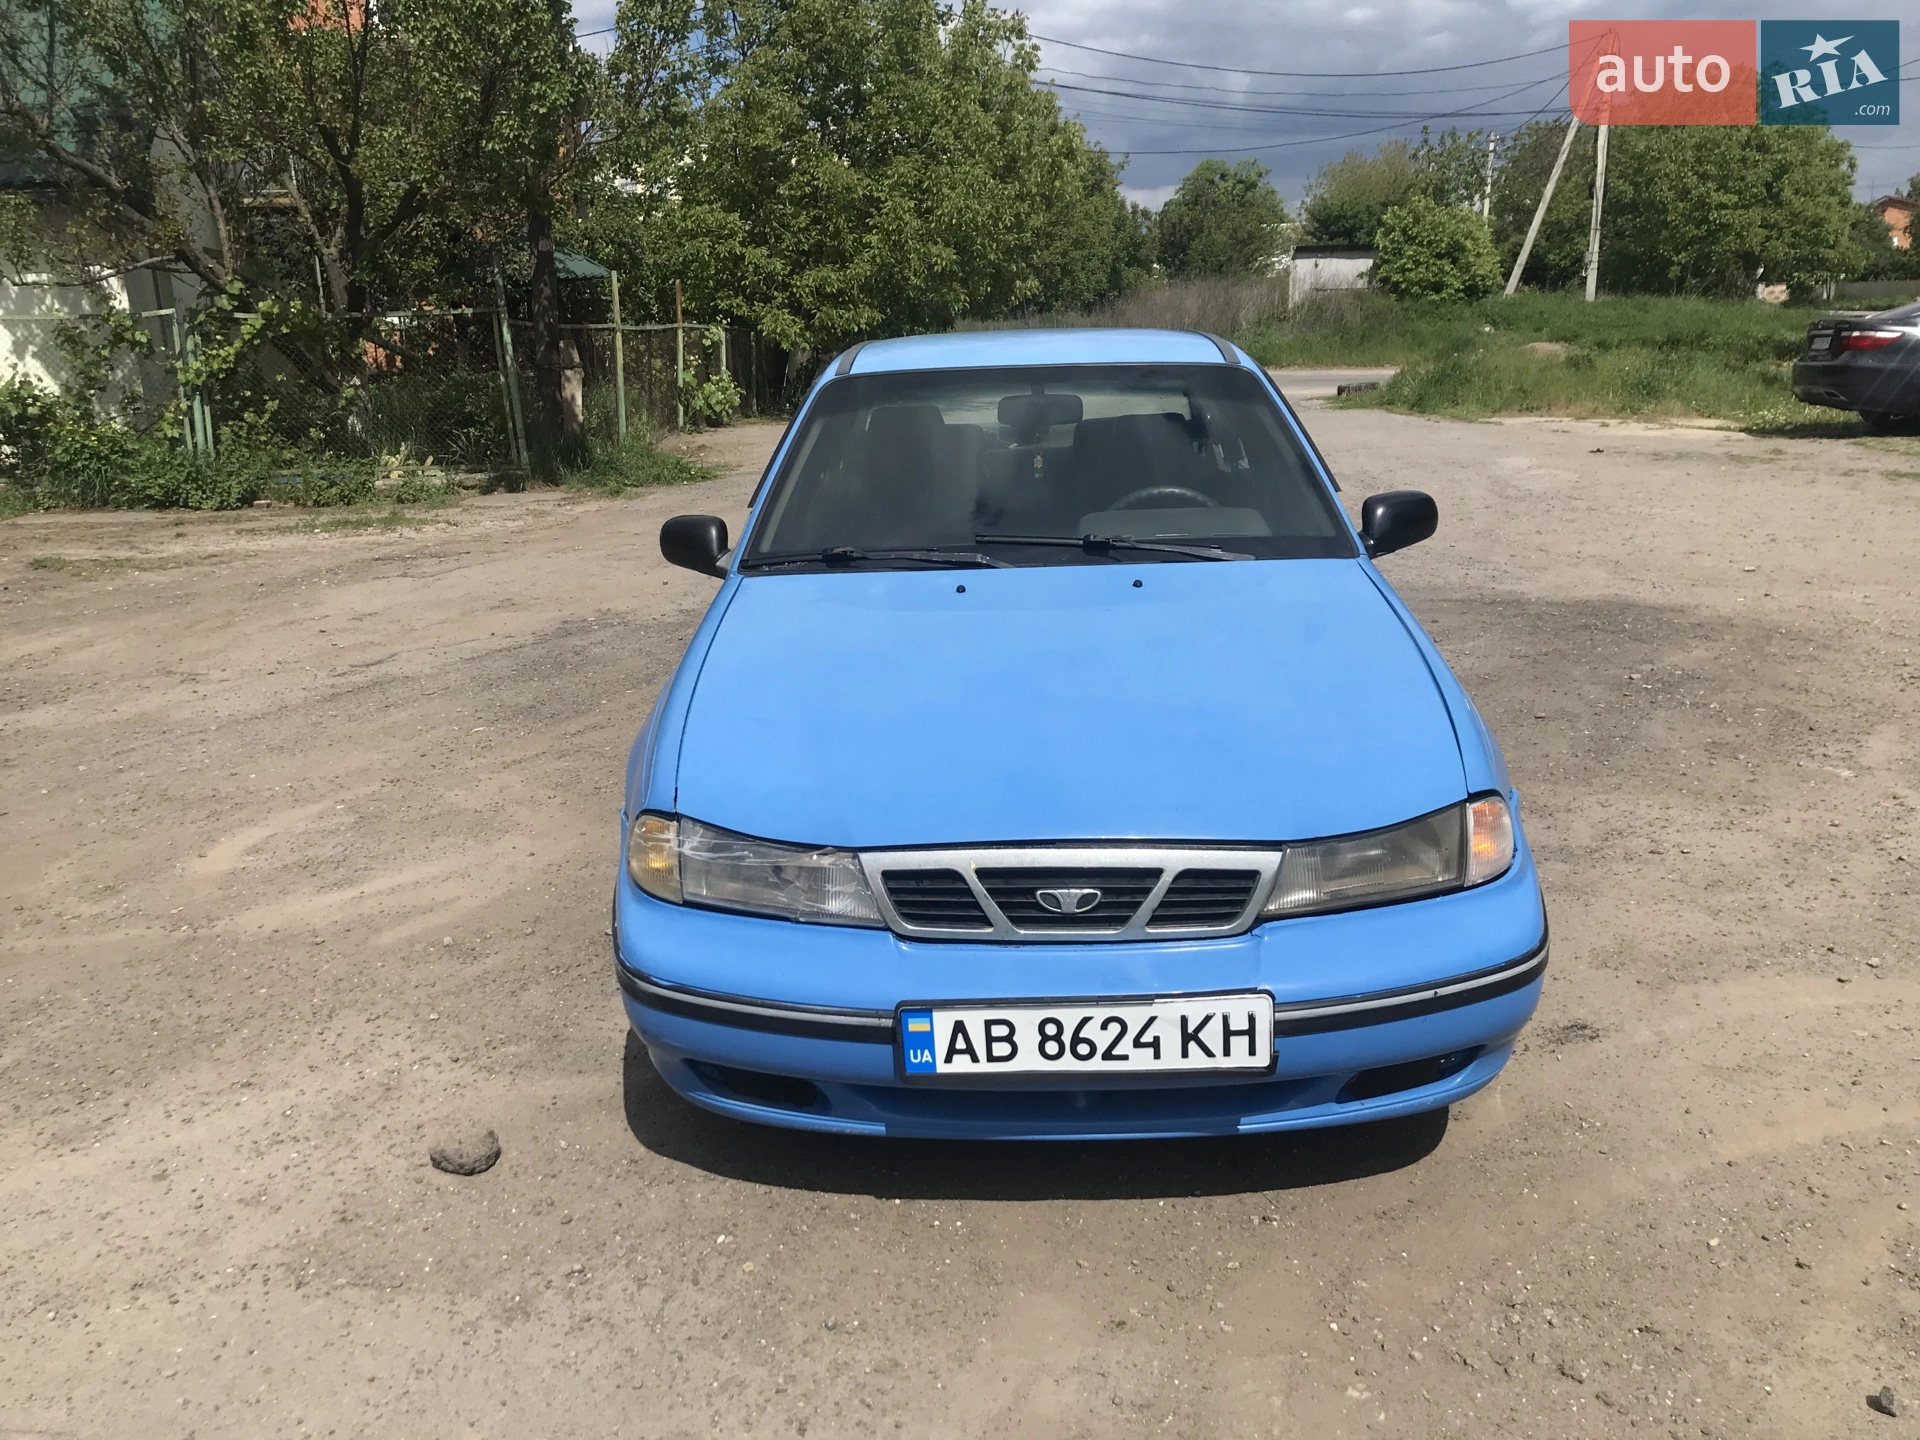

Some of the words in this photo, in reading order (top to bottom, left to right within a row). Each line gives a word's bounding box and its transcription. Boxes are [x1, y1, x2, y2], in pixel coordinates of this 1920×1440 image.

[943, 1018, 1019, 1064] AB
[1037, 1016, 1162, 1061] 8624
[1181, 1011, 1257, 1059] KH
[910, 1048, 933, 1063] UA
